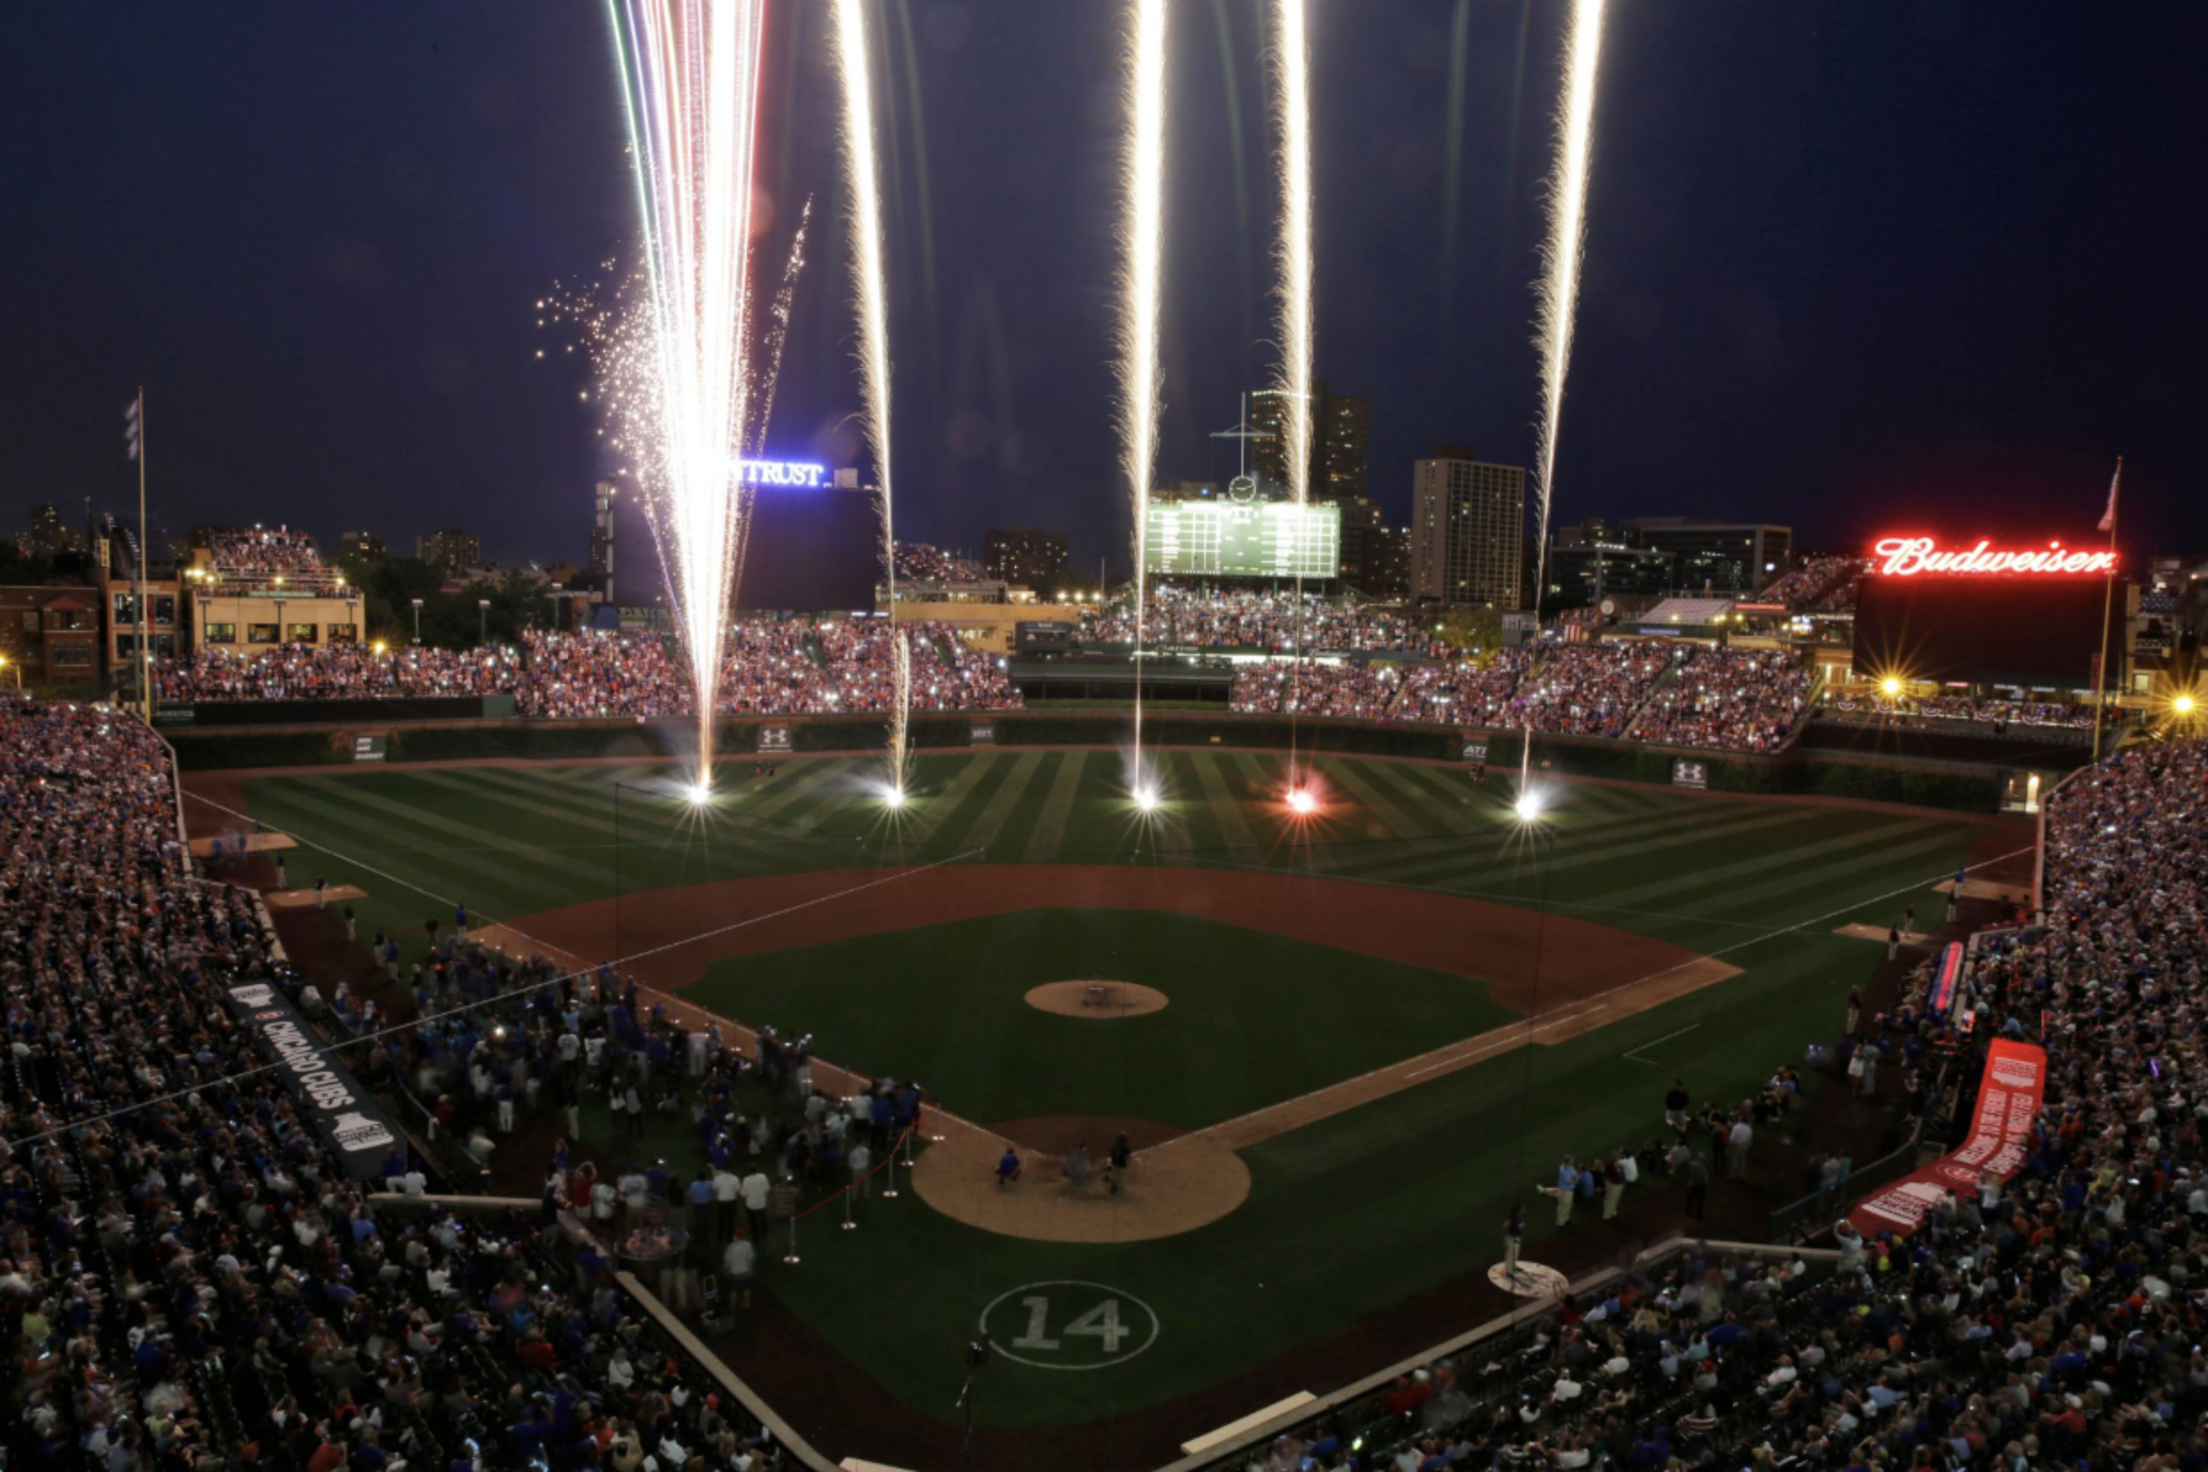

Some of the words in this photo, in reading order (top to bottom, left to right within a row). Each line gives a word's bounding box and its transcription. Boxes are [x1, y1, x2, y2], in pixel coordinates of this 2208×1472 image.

[739, 461, 824, 486] TRUST
[1875, 537, 2116, 575] Budweiser
[263, 1021, 326, 1072] CHICAGO
[300, 1071, 356, 1109] CUBS
[1011, 1296, 1129, 1352] 14
